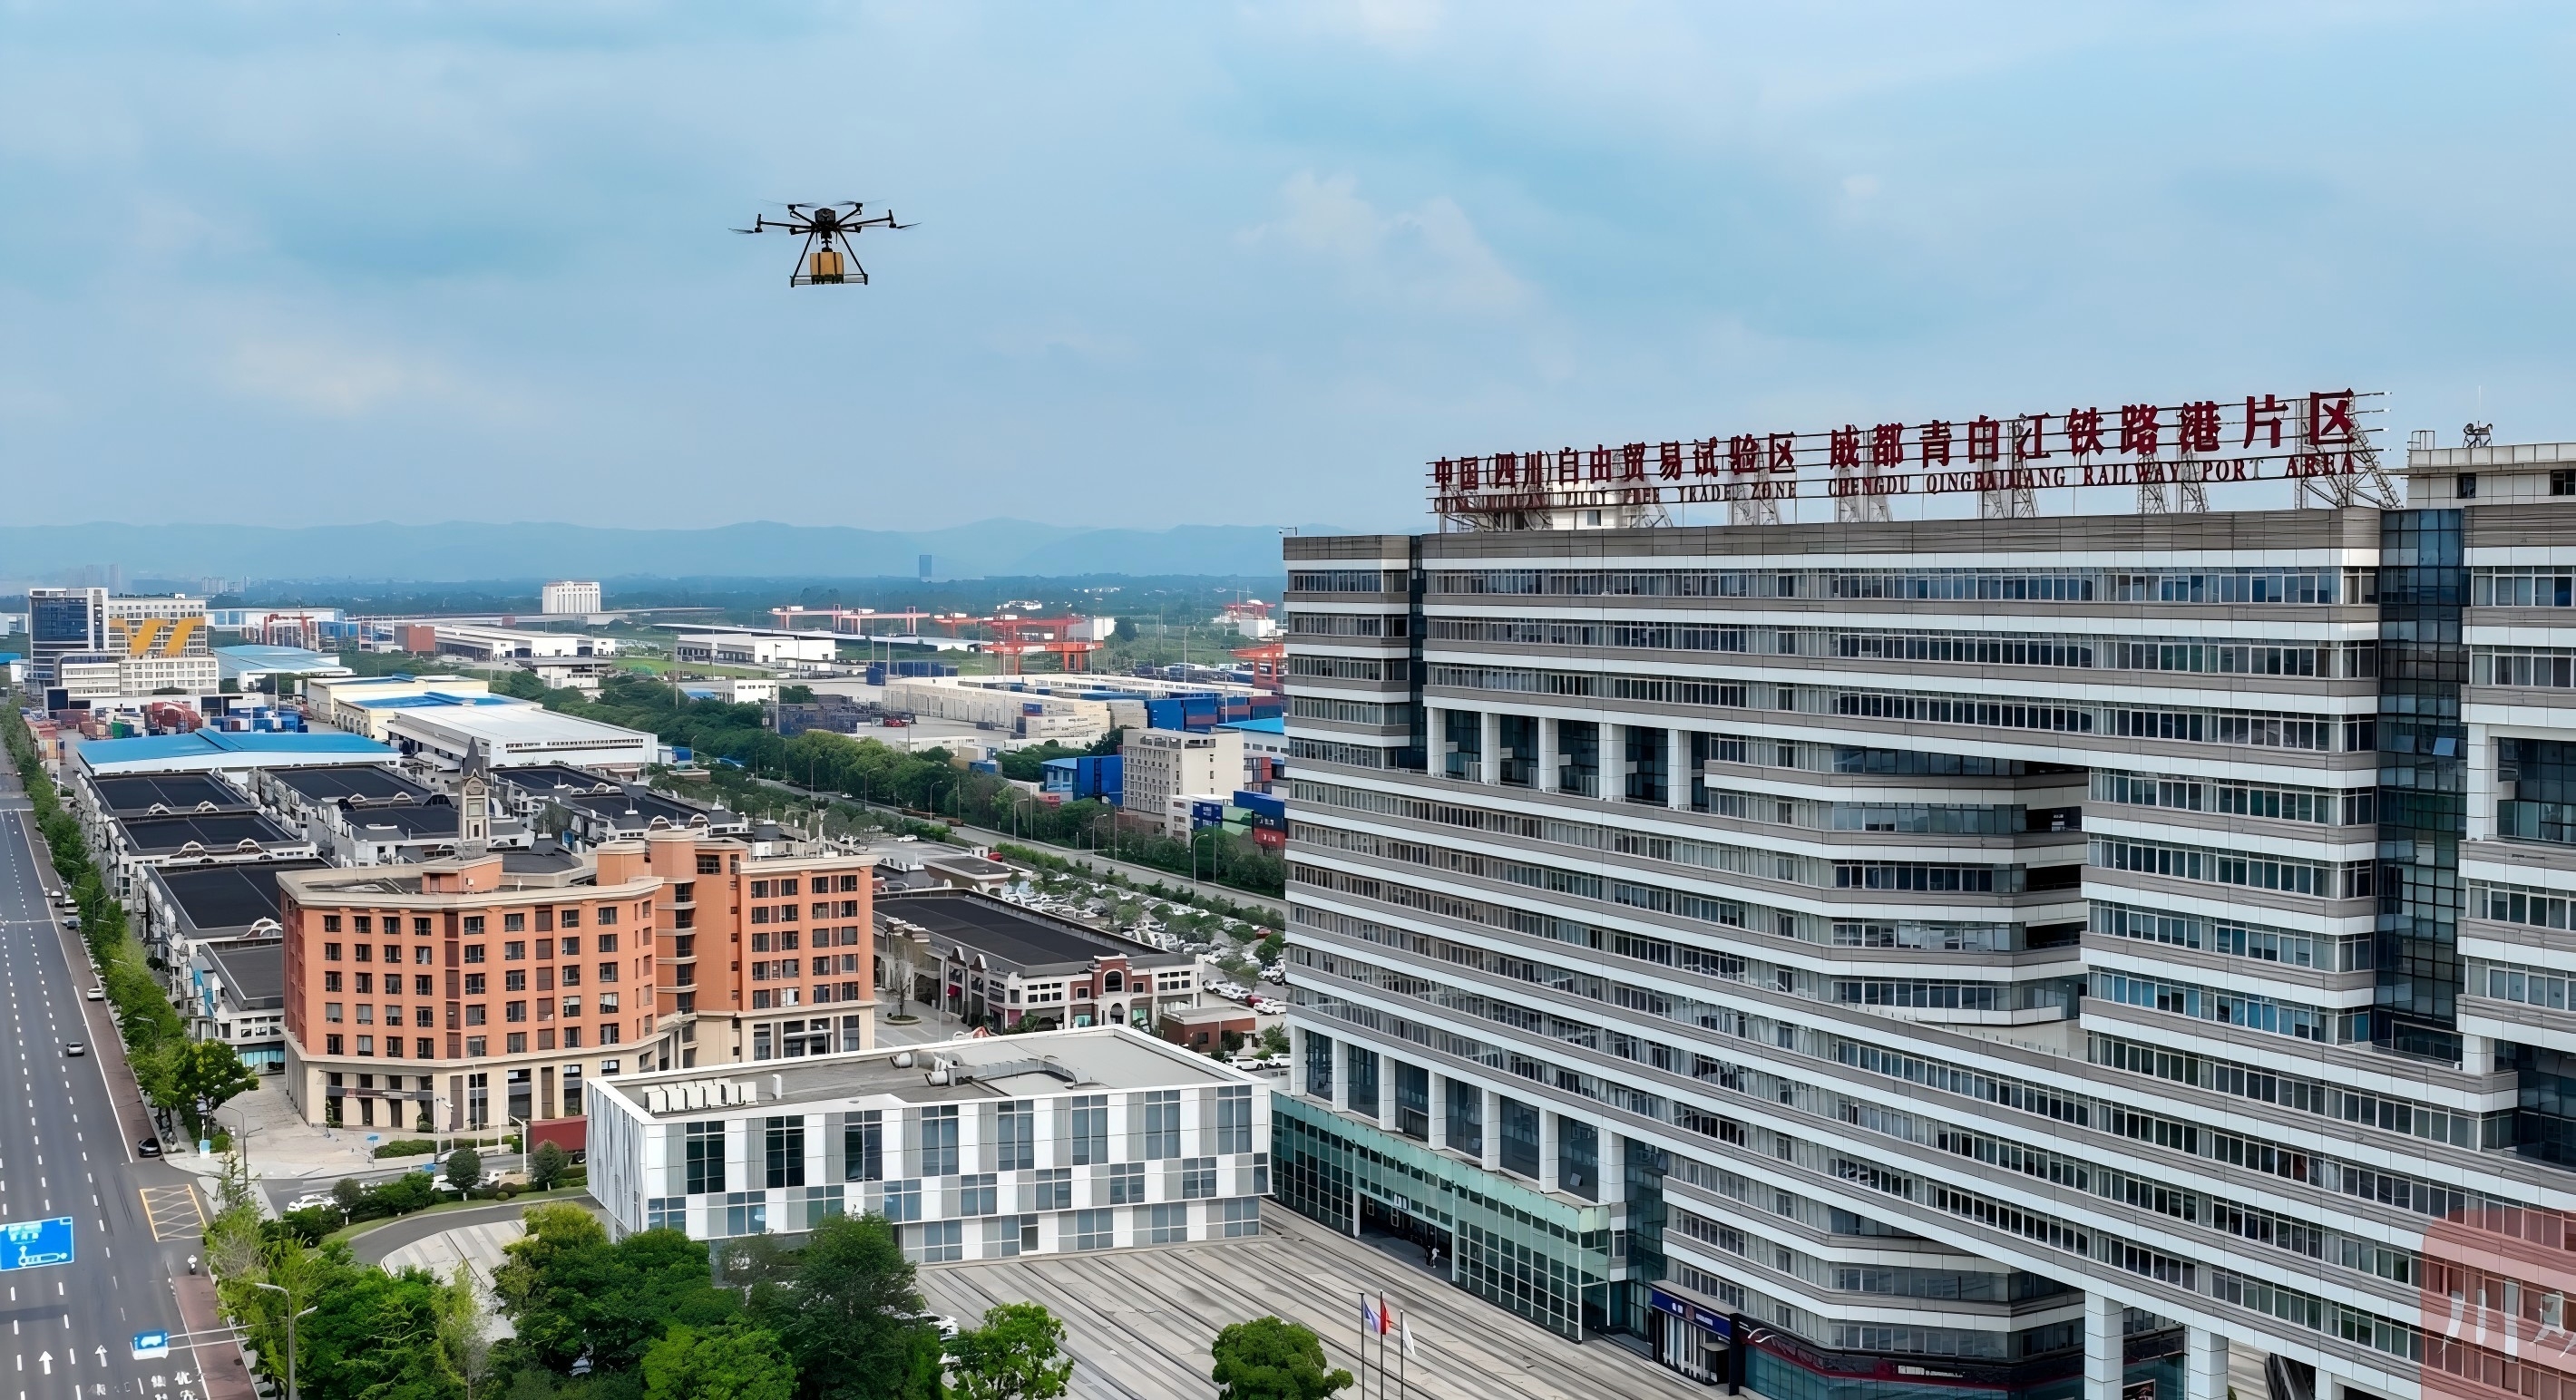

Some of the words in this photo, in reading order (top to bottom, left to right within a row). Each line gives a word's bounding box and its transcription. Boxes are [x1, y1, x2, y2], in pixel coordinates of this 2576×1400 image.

[1829, 388, 2356, 469] 成都青白江铁路港片区
[1679, 483, 1736, 502] TRADE
[1751, 481, 1797, 500] ZONE
[1828, 475, 1910, 496] CHENGDU
[2083, 462, 2181, 486] RAILWAY
[2201, 458, 2264, 481] PORT
[2285, 452, 2356, 478] AREA
